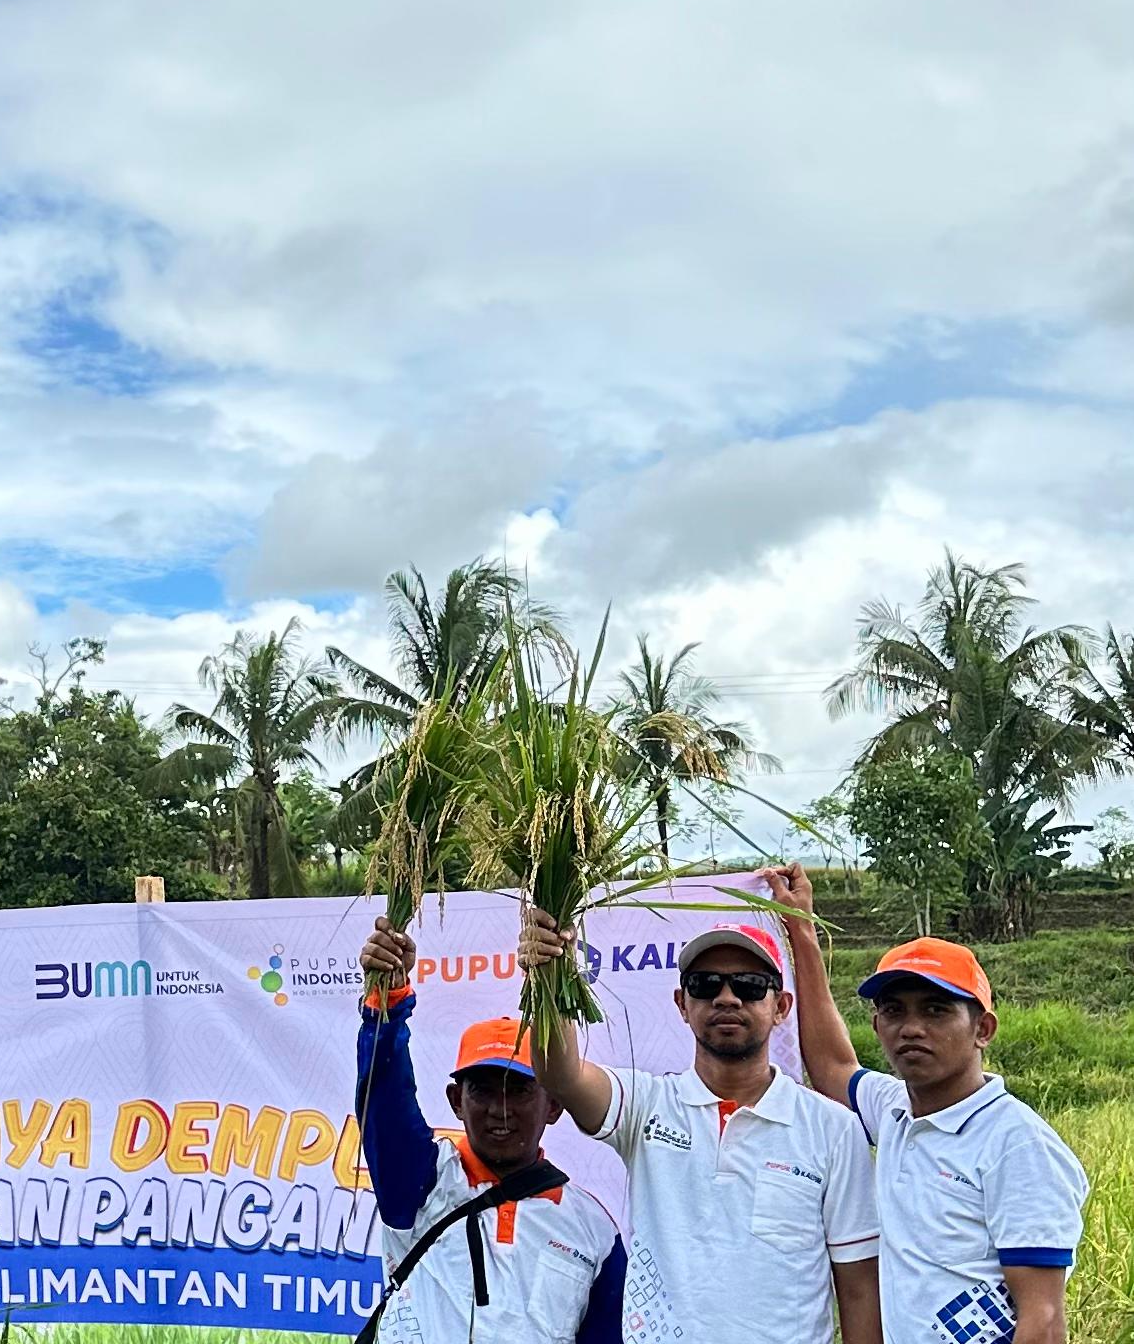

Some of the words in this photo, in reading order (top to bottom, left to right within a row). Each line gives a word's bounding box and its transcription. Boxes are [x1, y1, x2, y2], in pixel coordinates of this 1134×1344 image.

[156, 970, 200, 982] UNTUK
[290, 957, 358, 971] PUPU
[417, 953, 527, 984] PUPU
[611, 942, 687, 972] KAL
[156, 983, 224, 996] INDONESIA
[292, 972, 364, 986] INDONES
[111, 1099, 374, 1189] DEMPL
[77, 1177, 379, 1261] PANGAN
[263, 1273, 382, 1318] TIMU
